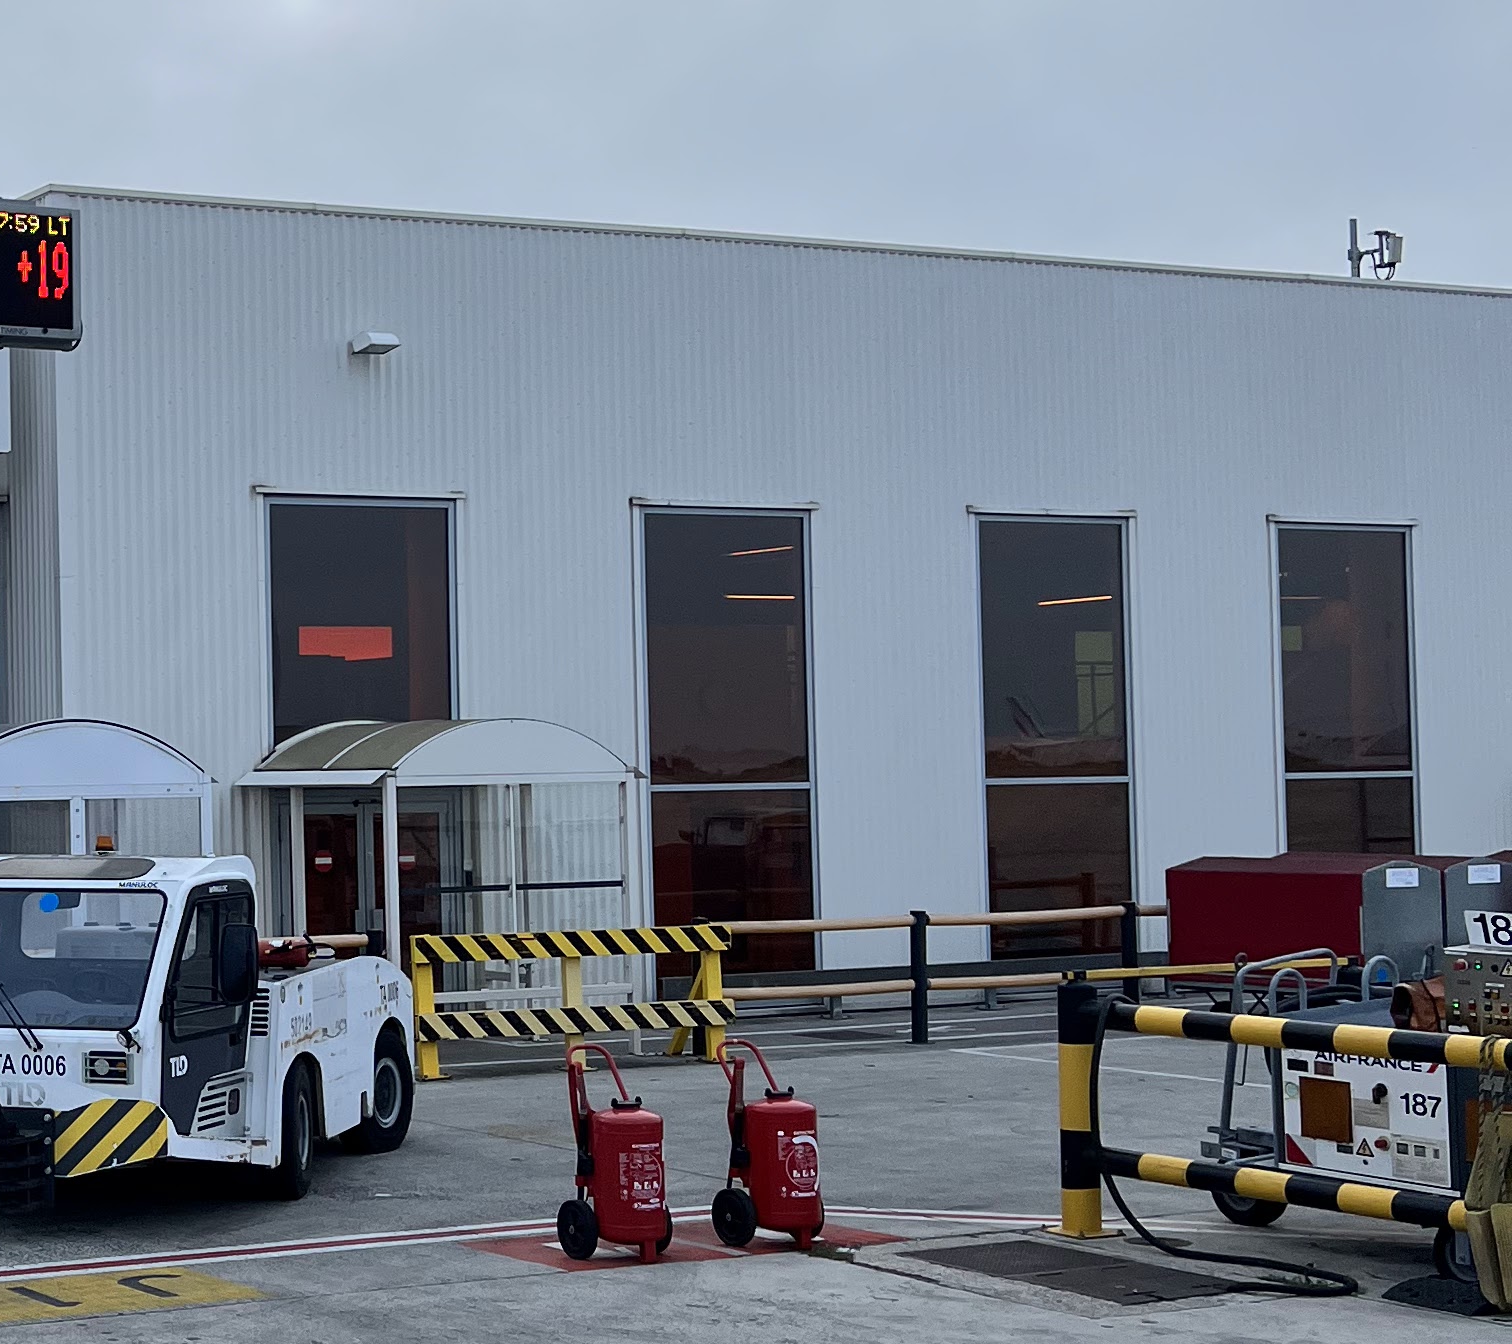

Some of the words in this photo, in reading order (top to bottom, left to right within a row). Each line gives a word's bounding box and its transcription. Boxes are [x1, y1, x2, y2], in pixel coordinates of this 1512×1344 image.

[48, 216, 70, 236] LT
[17, 240, 69, 299] +19
[21, 1054, 66, 1076] 0006
[0, 1081, 46, 1107] TLD
[1399, 1092, 1442, 1118] 187
